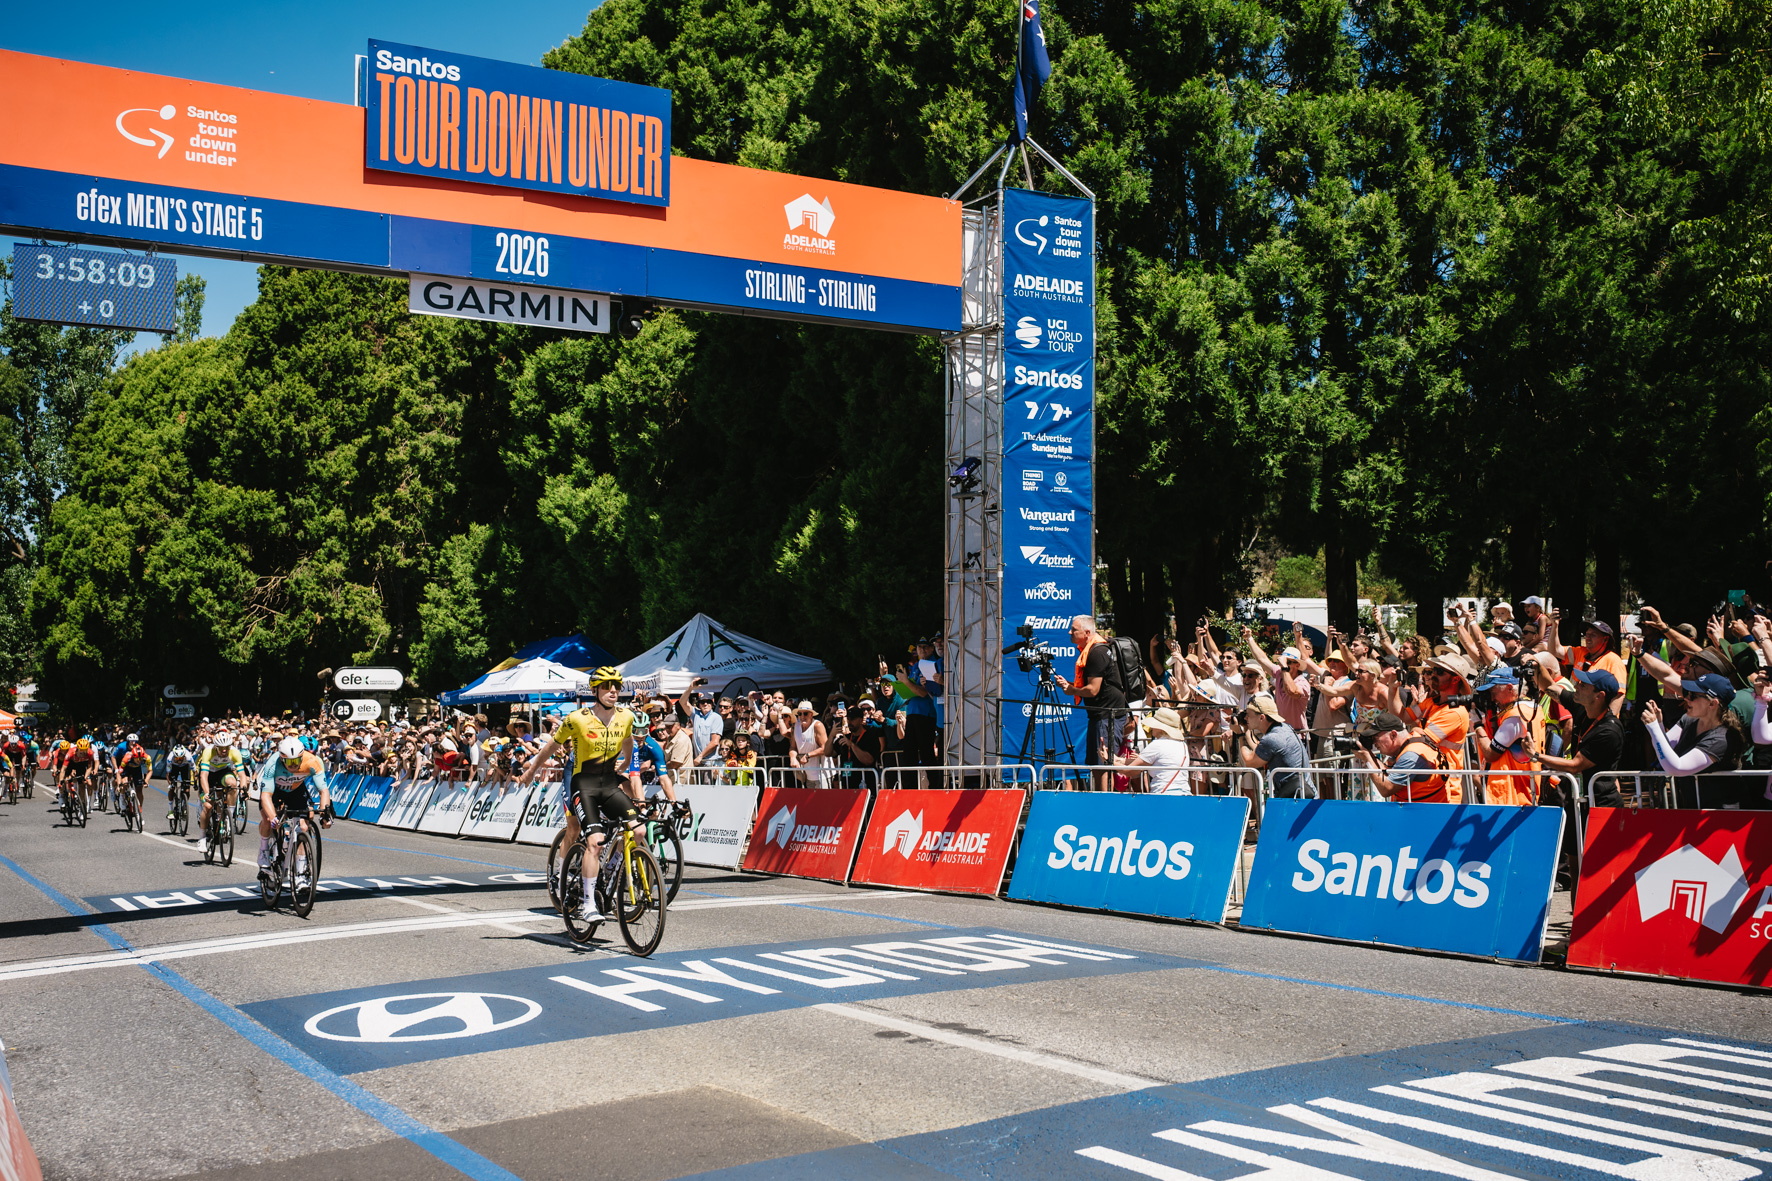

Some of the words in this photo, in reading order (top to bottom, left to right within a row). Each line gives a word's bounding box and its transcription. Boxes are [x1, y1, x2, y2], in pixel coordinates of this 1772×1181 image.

[376, 49, 461, 82] Santos
[187, 105, 238, 124] Santos
[198, 122, 237, 138] tour
[376, 72, 460, 171] TOUR
[466, 86, 563, 185] DOWN
[567, 102, 664, 198] UNDER
[189, 134, 237, 152] down
[185, 150, 237, 166] under
[76, 188, 122, 225] efex
[191, 201, 247, 239] STAGE
[251, 208, 263, 241] 5
[1054, 215, 1082, 228] Santos
[1060, 227, 1082, 238] tour
[783, 234, 836, 251] ADELAIDE
[783, 244, 802, 252] SOUTH
[804, 246, 836, 256] AUSTRALIA
[1055, 236, 1082, 248] down
[495, 232, 549, 277] 2026
[1052, 247, 1082, 259] under
[36, 253, 156, 289] 3:58:09
[745, 269, 806, 304] STIRLING
[818, 278, 876, 313] STIRLING
[1013, 273, 1084, 296] ADELAIDE
[423, 281, 599, 326] GARMIN
[1013, 288, 1040, 299] SOUTH
[1042, 292, 1084, 304] AUSTRALIA
[1047, 318, 1068, 331] UCI
[1047, 329, 1083, 343] WORLD
[1047, 340, 1075, 353] TOUR
[1014, 365, 1083, 390] Santos
[1022, 431, 1036, 441] The
[1035, 432, 1073, 443] Advertiser
[1031, 443, 1059, 454] Sunday
[1058, 445, 1073, 454] Mail
[1019, 507, 1076, 524] Vanguard
[1028, 525, 1045, 533] Strong
[1024, 588, 1072, 600] WHOOSH
[701, 657, 746, 672] Adelaide
[337, 704, 351, 716] 25
[600, 730, 624, 738] VISMA
[469, 795, 500, 822] efex
[525, 798, 557, 828] efex
[792, 824, 843, 845] ADELAIDE
[919, 830, 990, 854] ADELAIDE
[789, 842, 807, 851] SOUTH
[808, 844, 837, 855] AUSTRALIA
[1047, 824, 1195, 881] Santos
[915, 851, 941, 863] SOUTH
[942, 854, 984, 865] AUSTRALIA
[1291, 838, 1491, 909] Santos
[548, 933, 1138, 1012] HYUNDAI
